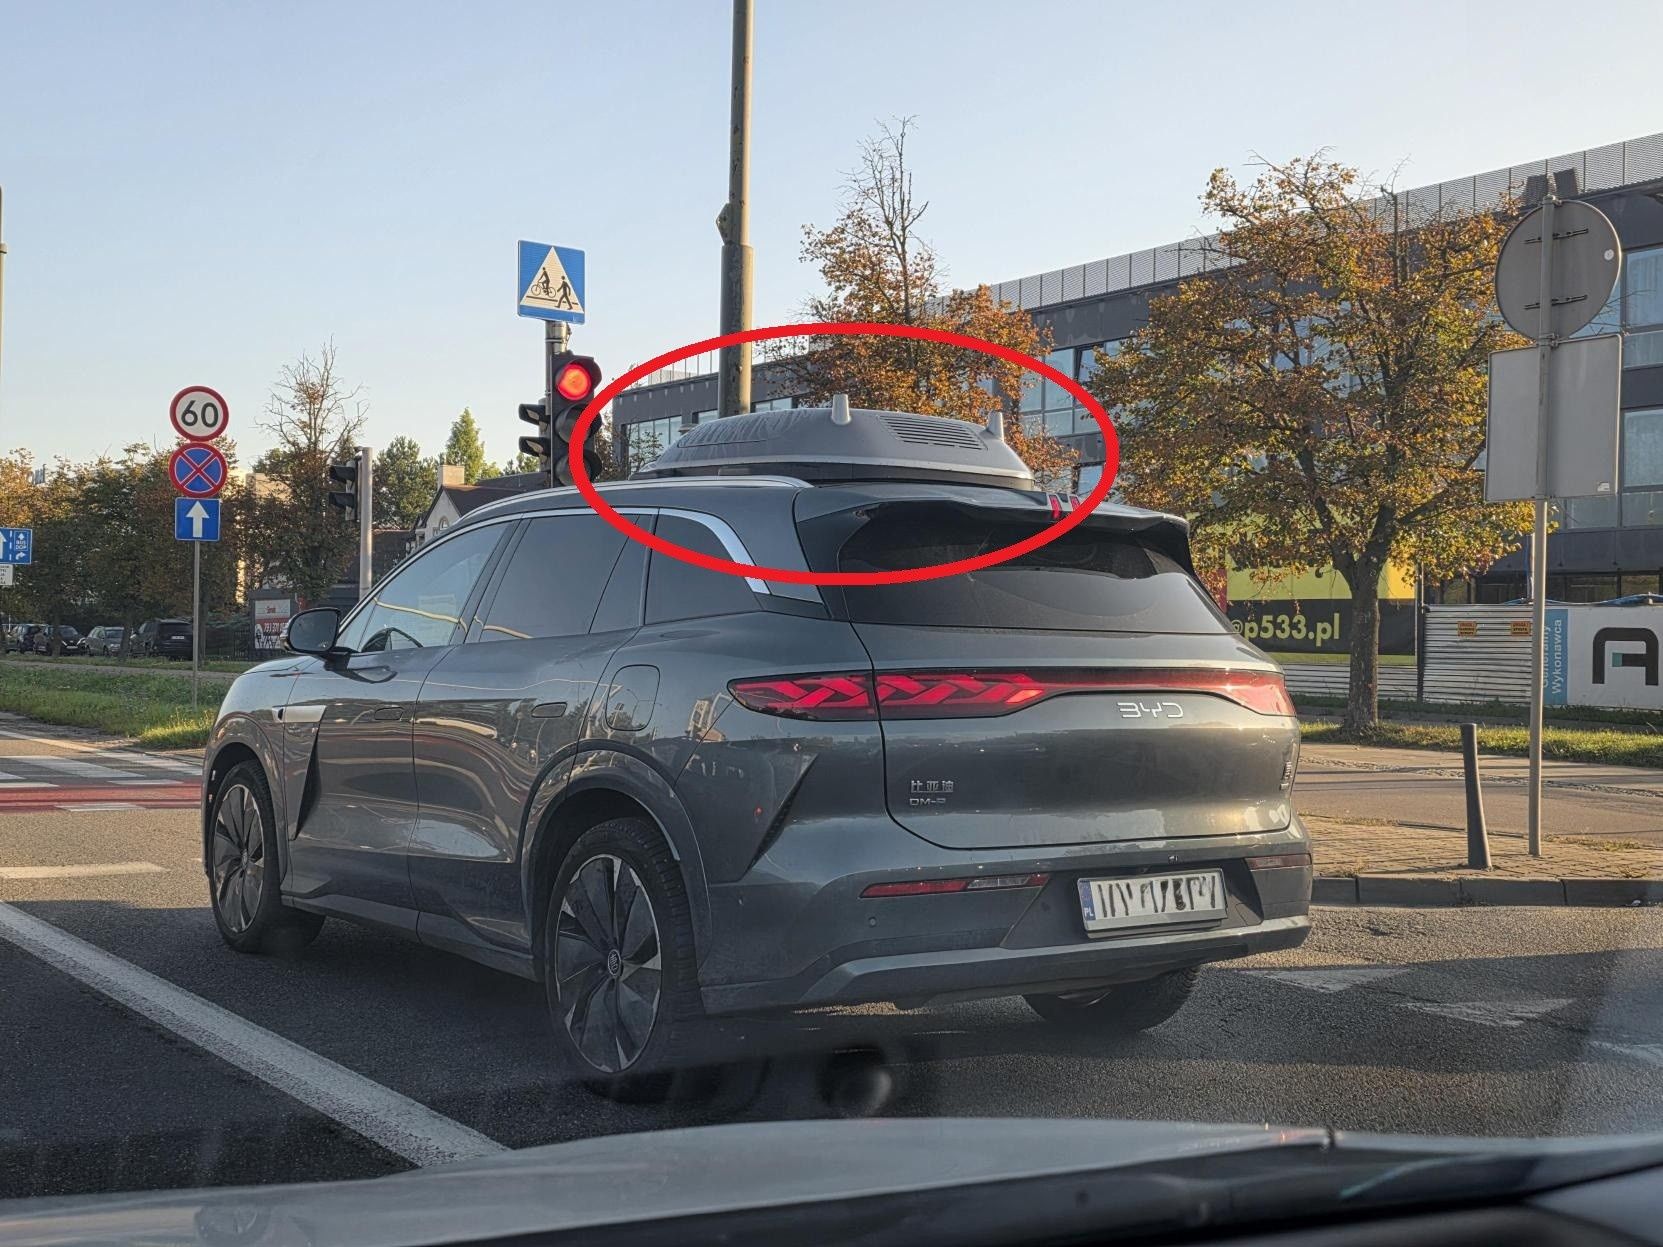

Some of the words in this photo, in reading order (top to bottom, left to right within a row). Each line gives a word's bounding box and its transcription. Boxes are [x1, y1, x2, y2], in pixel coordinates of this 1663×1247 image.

[181, 399, 219, 428] 60
[1551, 619, 1565, 694] Wykonawca
[1117, 702, 1184, 718] BYD
[1084, 907, 1095, 917] PL
